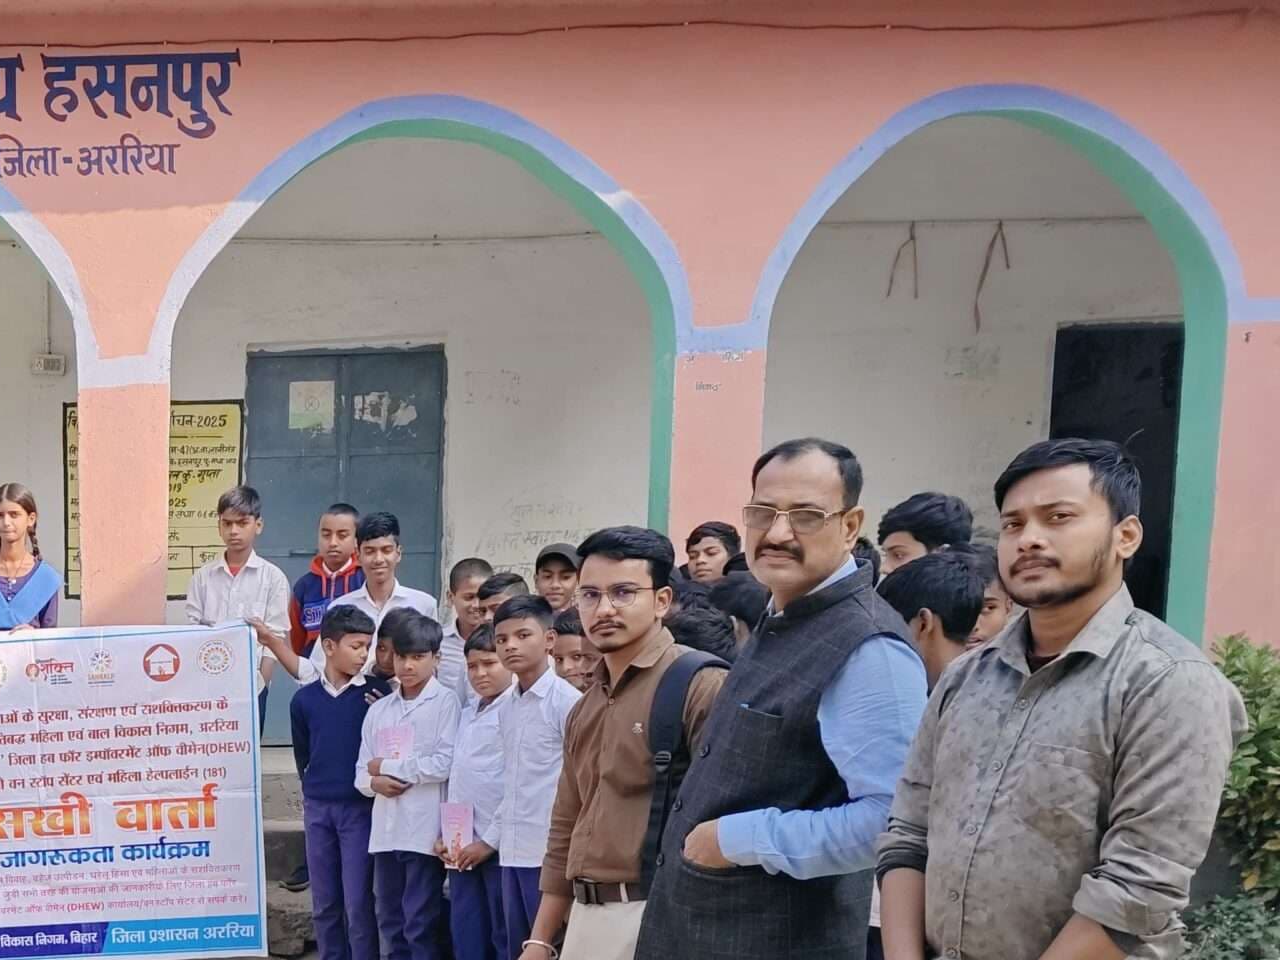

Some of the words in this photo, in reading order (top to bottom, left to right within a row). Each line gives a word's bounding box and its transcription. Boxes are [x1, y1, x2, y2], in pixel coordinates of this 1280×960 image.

[40, 48, 241, 139] हसनपुर
[197, 469, 223, 483] गुप्ता
[22, 708, 34, 721] के
[77, 705, 117, 720] संरक्षण
[121, 703, 137, 717] एवं
[216, 696, 229, 710] के
[30, 729, 64, 744] महिला
[67, 728, 84, 741] एवं
[87, 727, 110, 741] बाल
[114, 724, 152, 739] विकास
[198, 719, 239, 733] अररिया
[8, 752, 36, 767] जिला
[40, 752, 55, 764] हब
[59, 749, 82, 763] फॉर
[145, 744, 172, 758] ऑफ
[9, 777, 25, 790] वन
[29, 775, 55, 789] स्टॉप
[58, 772, 83, 787] सेंटर
[86, 771, 104, 785] एवं
[107, 768, 142, 783] महिला
[202, 766, 228, 781] (181)
[113, 783, 218, 832] वार्ता
[120, 836, 211, 861] कार्यक्रम
[67, 901, 105, 913] (DHEW)
[0, 933, 34, 948] विकास
[71, 930, 98, 945] बिहार
[111, 927, 146, 944] जिला
[149, 926, 199, 944] प्रशासन
[203, 921, 255, 940] अररिया
